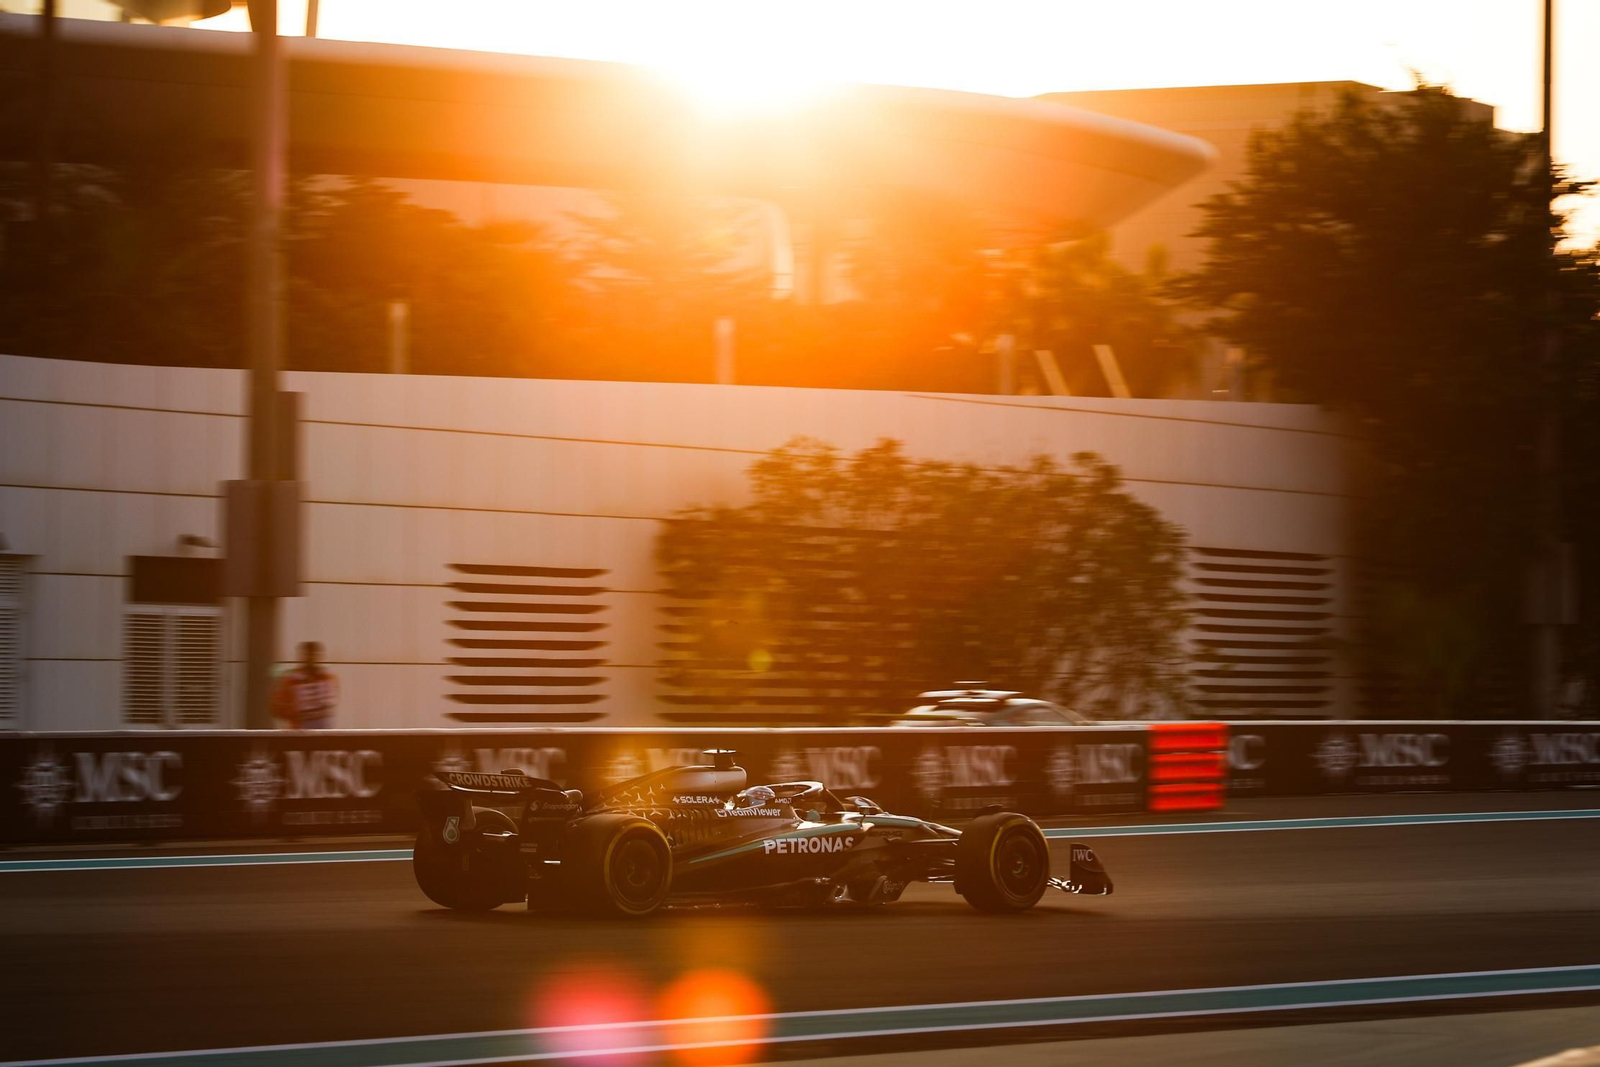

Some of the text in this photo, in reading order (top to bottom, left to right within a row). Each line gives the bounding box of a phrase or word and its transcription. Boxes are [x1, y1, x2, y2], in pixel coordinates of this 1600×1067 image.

[1073, 743, 1140, 784] MSC
[1357, 734, 1449, 767] MSC
[73, 751, 183, 802] MSC
[282, 750, 382, 799] MSC
[806, 746, 880, 791] MSC
[944, 745, 1016, 786] MSC
[448, 773, 533, 788] CROWDSTRIKE
[542, 800, 578, 811] Snapdragon
[680, 796, 714, 804] SOLERA
[728, 807, 781, 817] TeamViewer
[763, 836, 855, 855] PETRONAS
[1072, 849, 1093, 862] IWC
